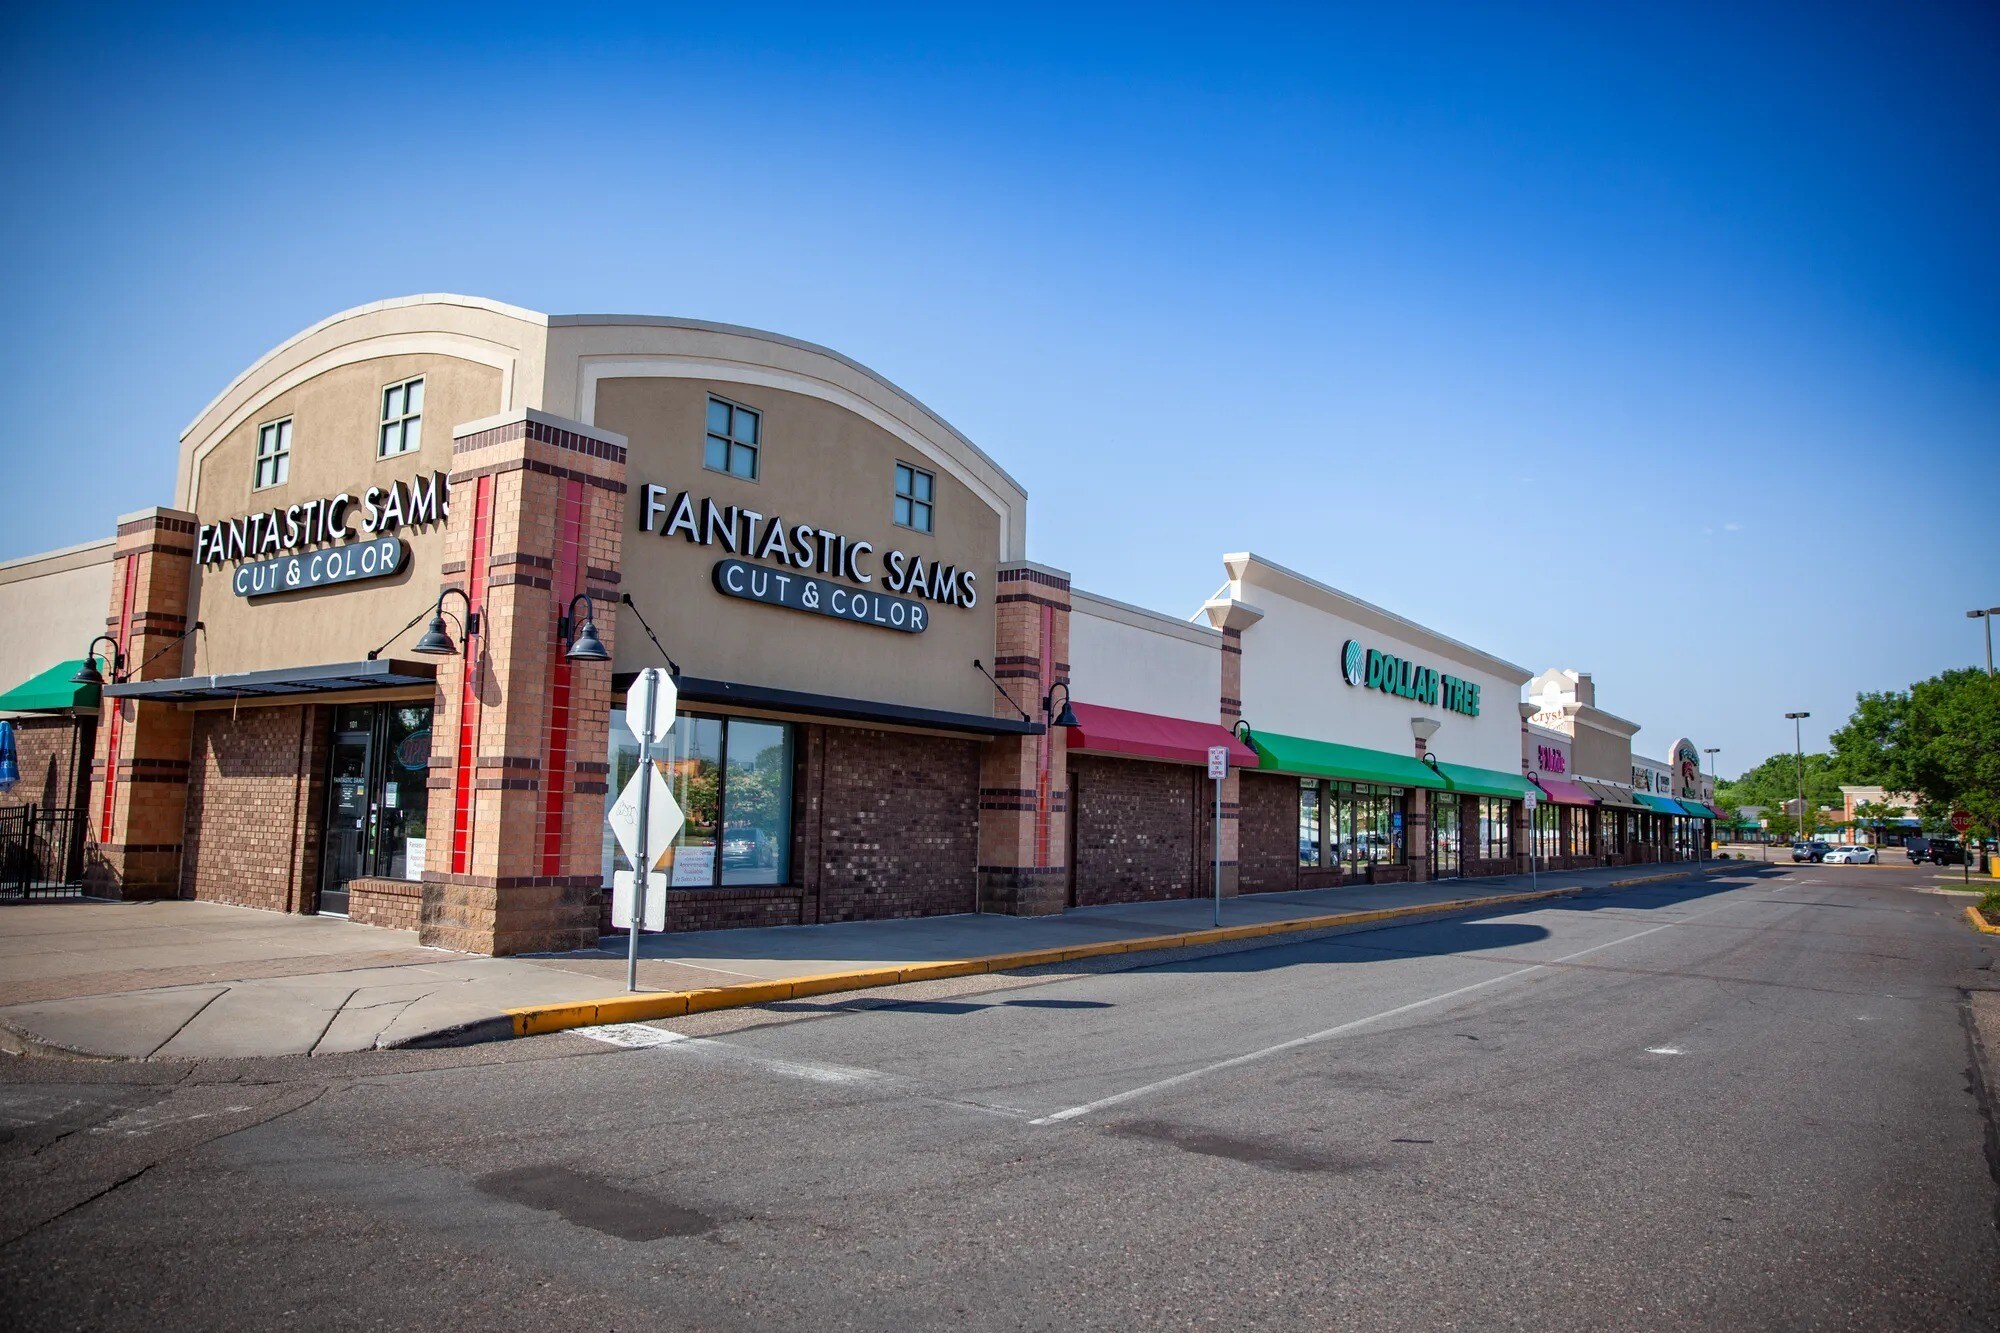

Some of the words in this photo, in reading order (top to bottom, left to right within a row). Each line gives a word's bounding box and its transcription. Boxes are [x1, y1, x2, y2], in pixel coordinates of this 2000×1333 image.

[196, 493, 350, 565] FANTASTIC
[643, 482, 873, 584] FANTASTIC
[885, 549, 977, 609] SAMS
[236, 563, 279, 593] CUT
[285, 559, 301, 586] &
[310, 542, 395, 582] COLOR
[726, 564, 791, 602] CUT
[801, 580, 819, 609] &
[831, 588, 923, 630] COLOR
[1366, 648, 1440, 706] DOLLAR
[1442, 674, 1481, 717] TREE
